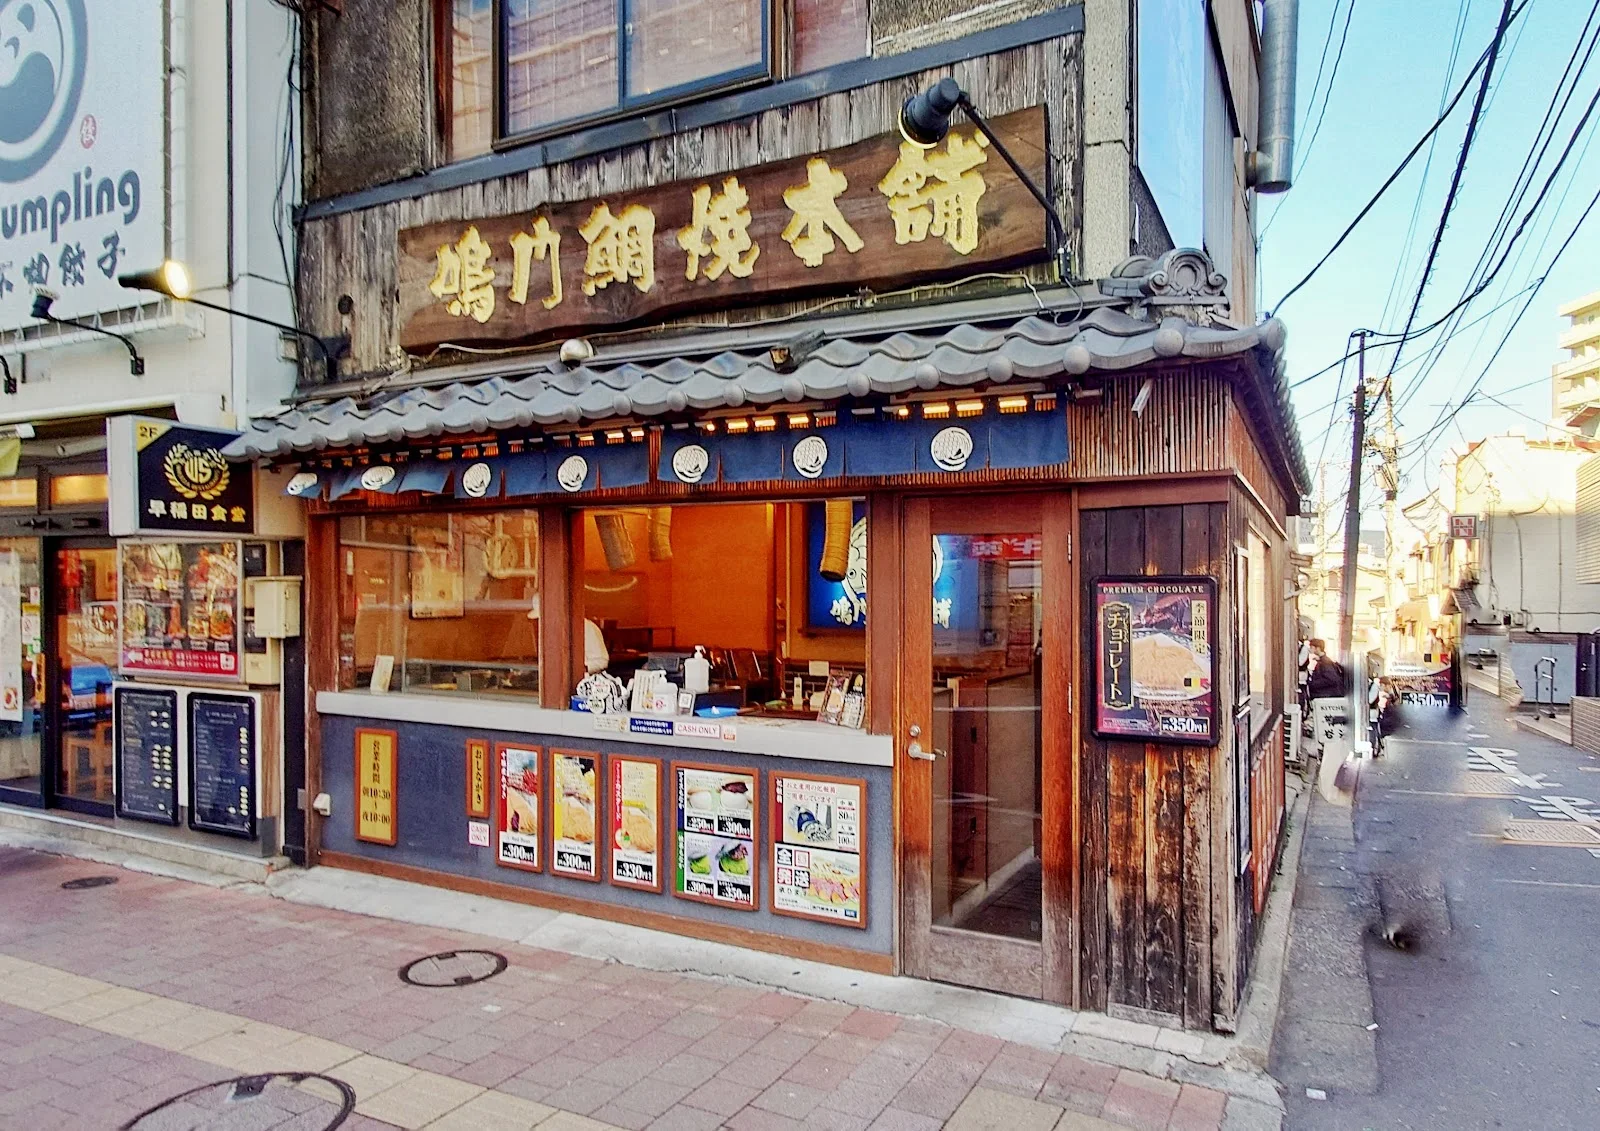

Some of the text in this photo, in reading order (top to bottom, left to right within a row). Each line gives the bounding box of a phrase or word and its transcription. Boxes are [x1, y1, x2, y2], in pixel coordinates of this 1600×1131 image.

[429, 128, 990, 324] 鳴門鯛焼本舗
[139, 425, 159, 439] 2F
[148, 499, 246, 523] 早稲田食堂
[1103, 585, 1205, 595] PREMIUM CHOCOLATE
[1107, 611, 1123, 700] チョコレート
[677, 723, 697, 733] CASH
[698, 725, 717, 735] ONLY
